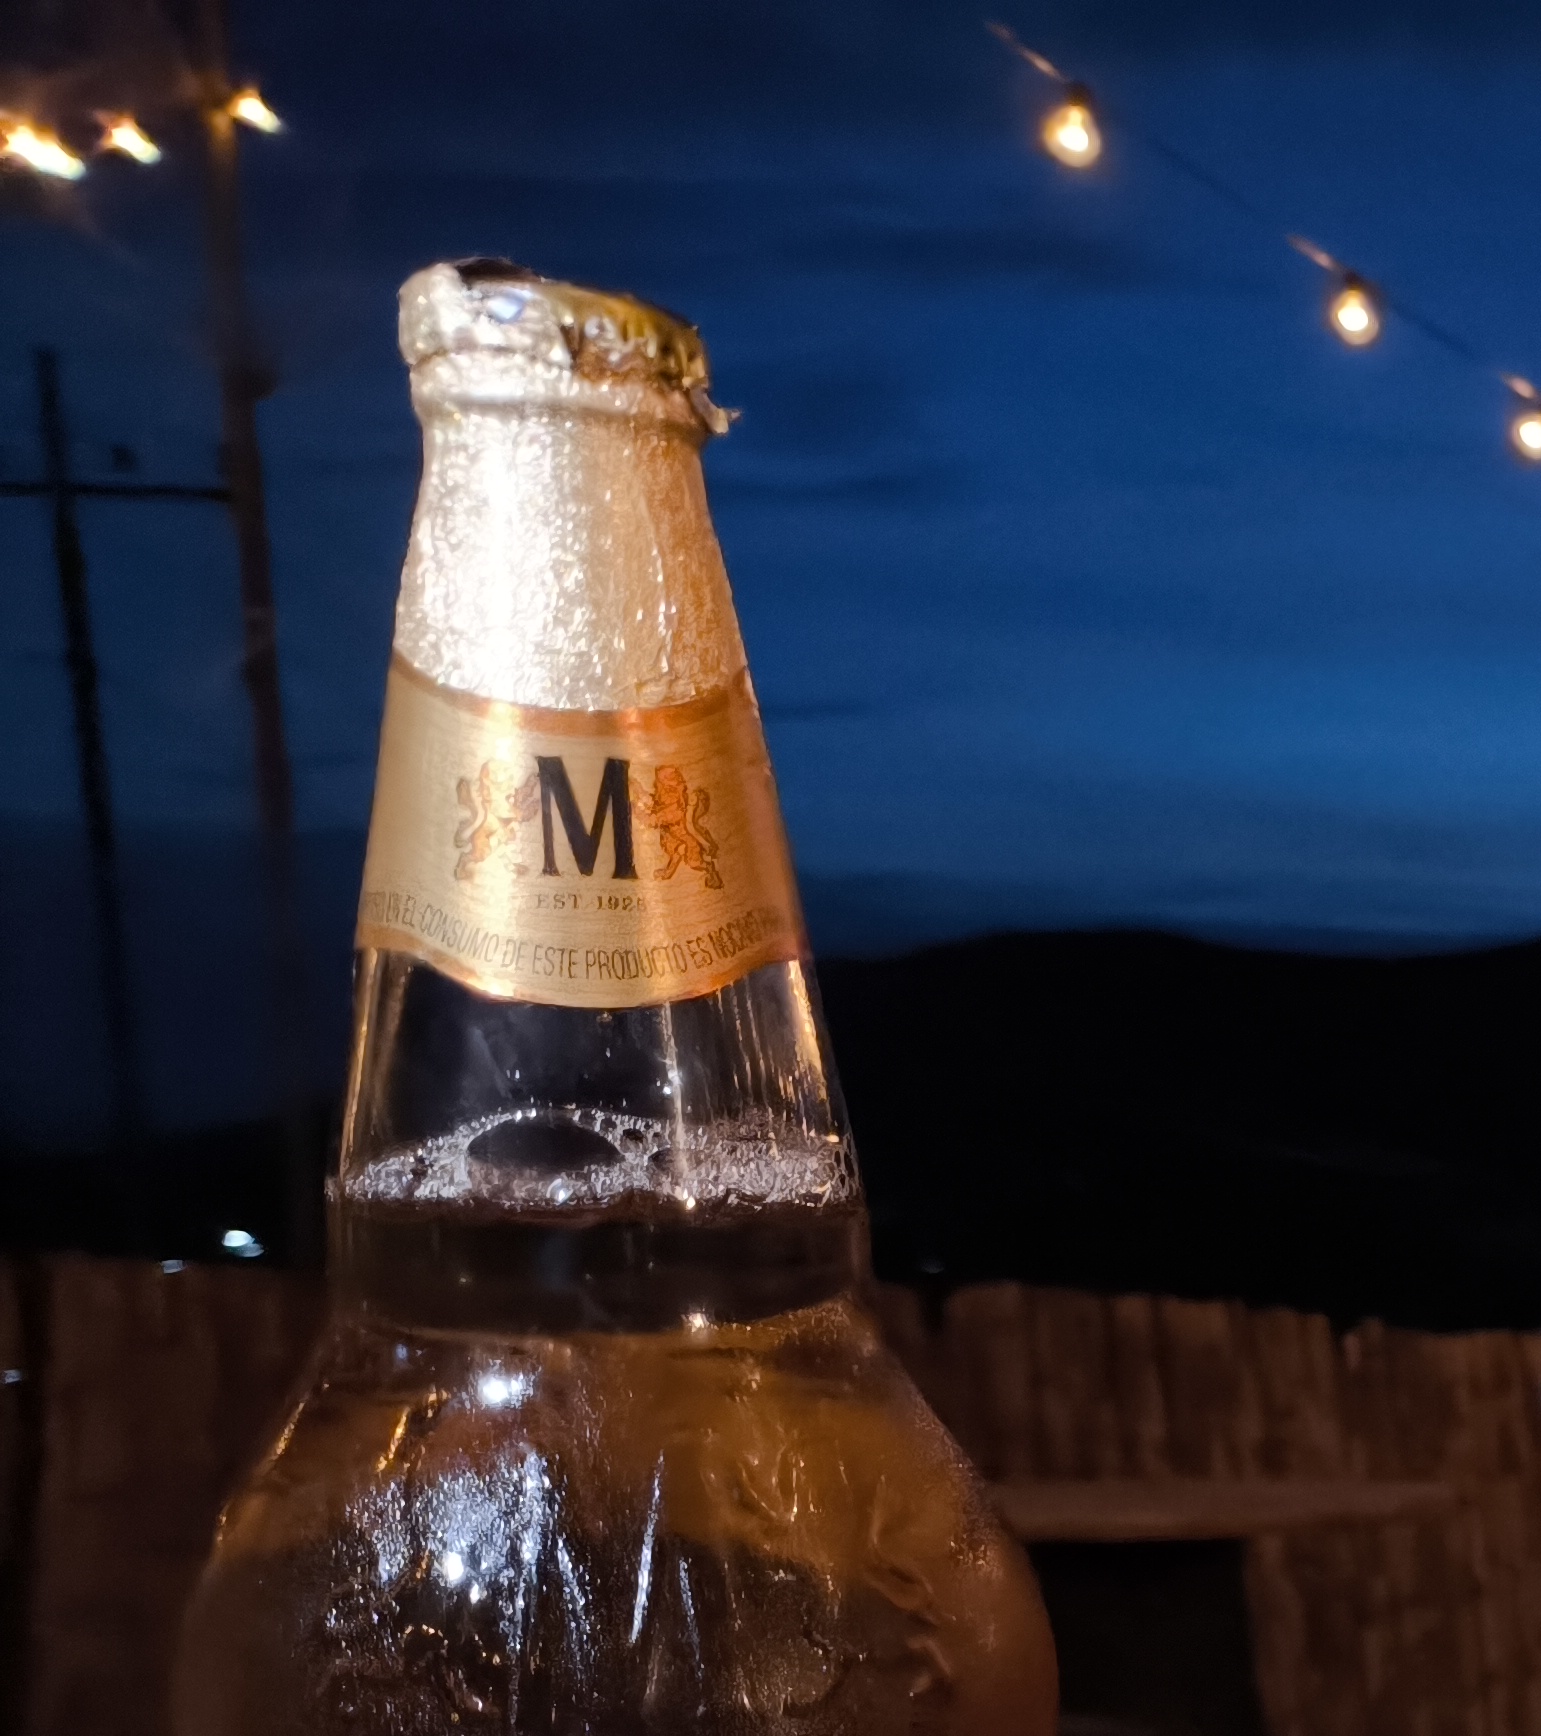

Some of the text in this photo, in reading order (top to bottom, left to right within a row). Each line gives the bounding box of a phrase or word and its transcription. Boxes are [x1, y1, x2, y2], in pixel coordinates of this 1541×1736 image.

[536, 756, 639, 879] M
[419, 903, 500, 963] CONSUMO
[501, 938, 529, 971] DE
[531, 944, 579, 980] ESTE
[585, 942, 688, 981] PRODUCTO
